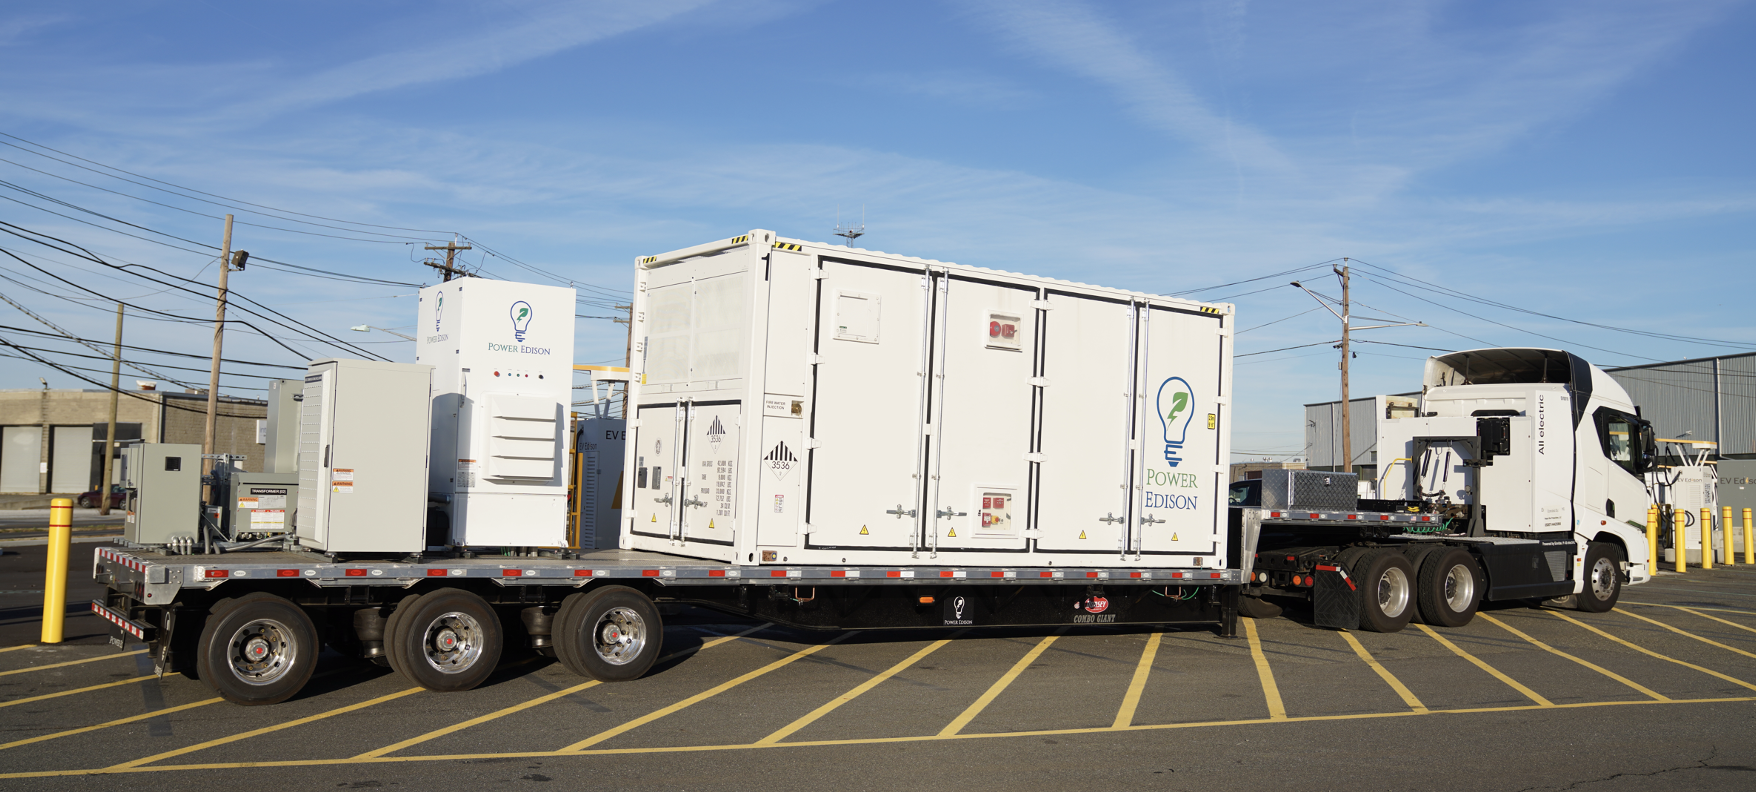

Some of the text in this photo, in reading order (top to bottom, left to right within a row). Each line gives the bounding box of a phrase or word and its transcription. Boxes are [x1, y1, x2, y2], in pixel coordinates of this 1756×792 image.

[761, 252, 770, 281] 1
[488, 342, 551, 356] POWER EDISON
[605, 430, 619, 440] EV
[771, 460, 790, 470] 3536
[1146, 469, 1198, 488] POWER
[1720, 477, 1732, 485] EV
[1145, 491, 1198, 510] EDISON
[1073, 613, 1116, 623] COMBO GIANT
